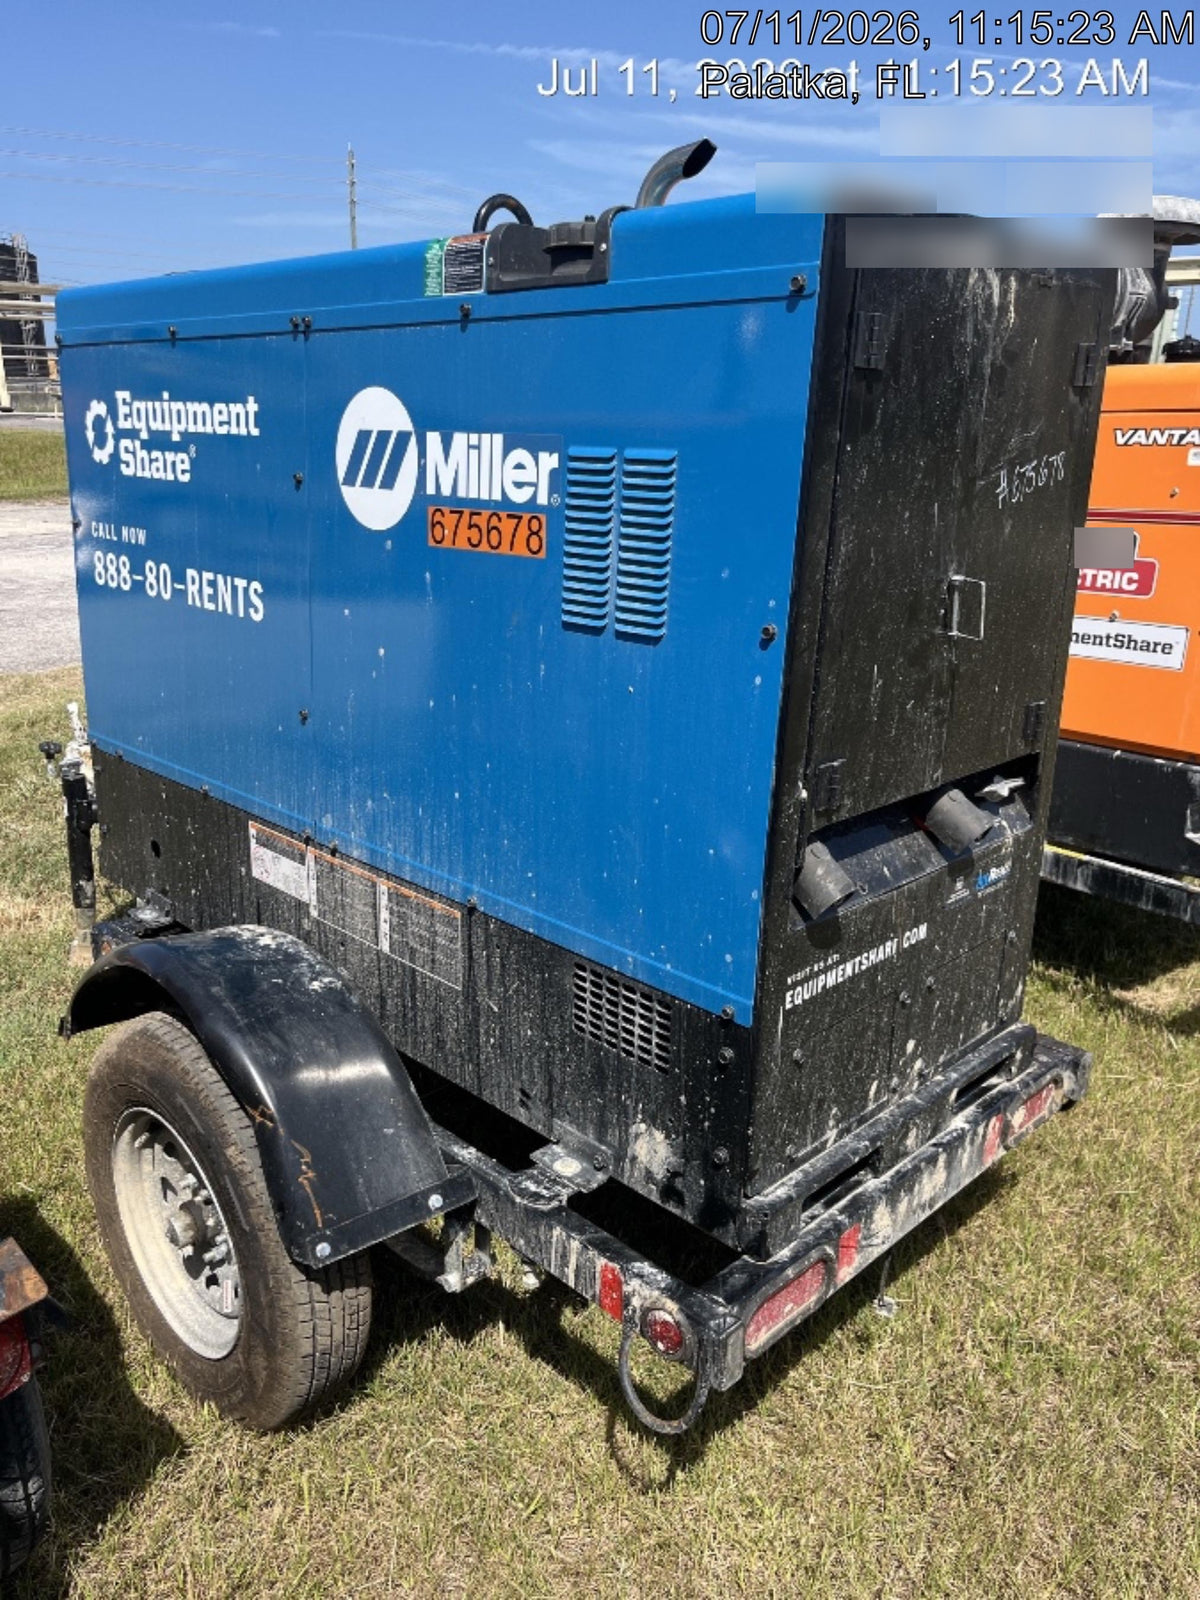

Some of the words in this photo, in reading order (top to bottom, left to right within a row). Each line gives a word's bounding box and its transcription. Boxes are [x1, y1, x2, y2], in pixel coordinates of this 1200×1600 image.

[115, 390, 260, 441] Equipment
[1114, 428, 1200, 447] VANTA
[91, 521, 118, 541] CALL
[122, 525, 146, 546] NOW
[430, 508, 543, 556] 675678
[94, 550, 265, 622] 888-80-RENTS
[785, 922, 927, 1010] EQUIPMENTSHARCOM
